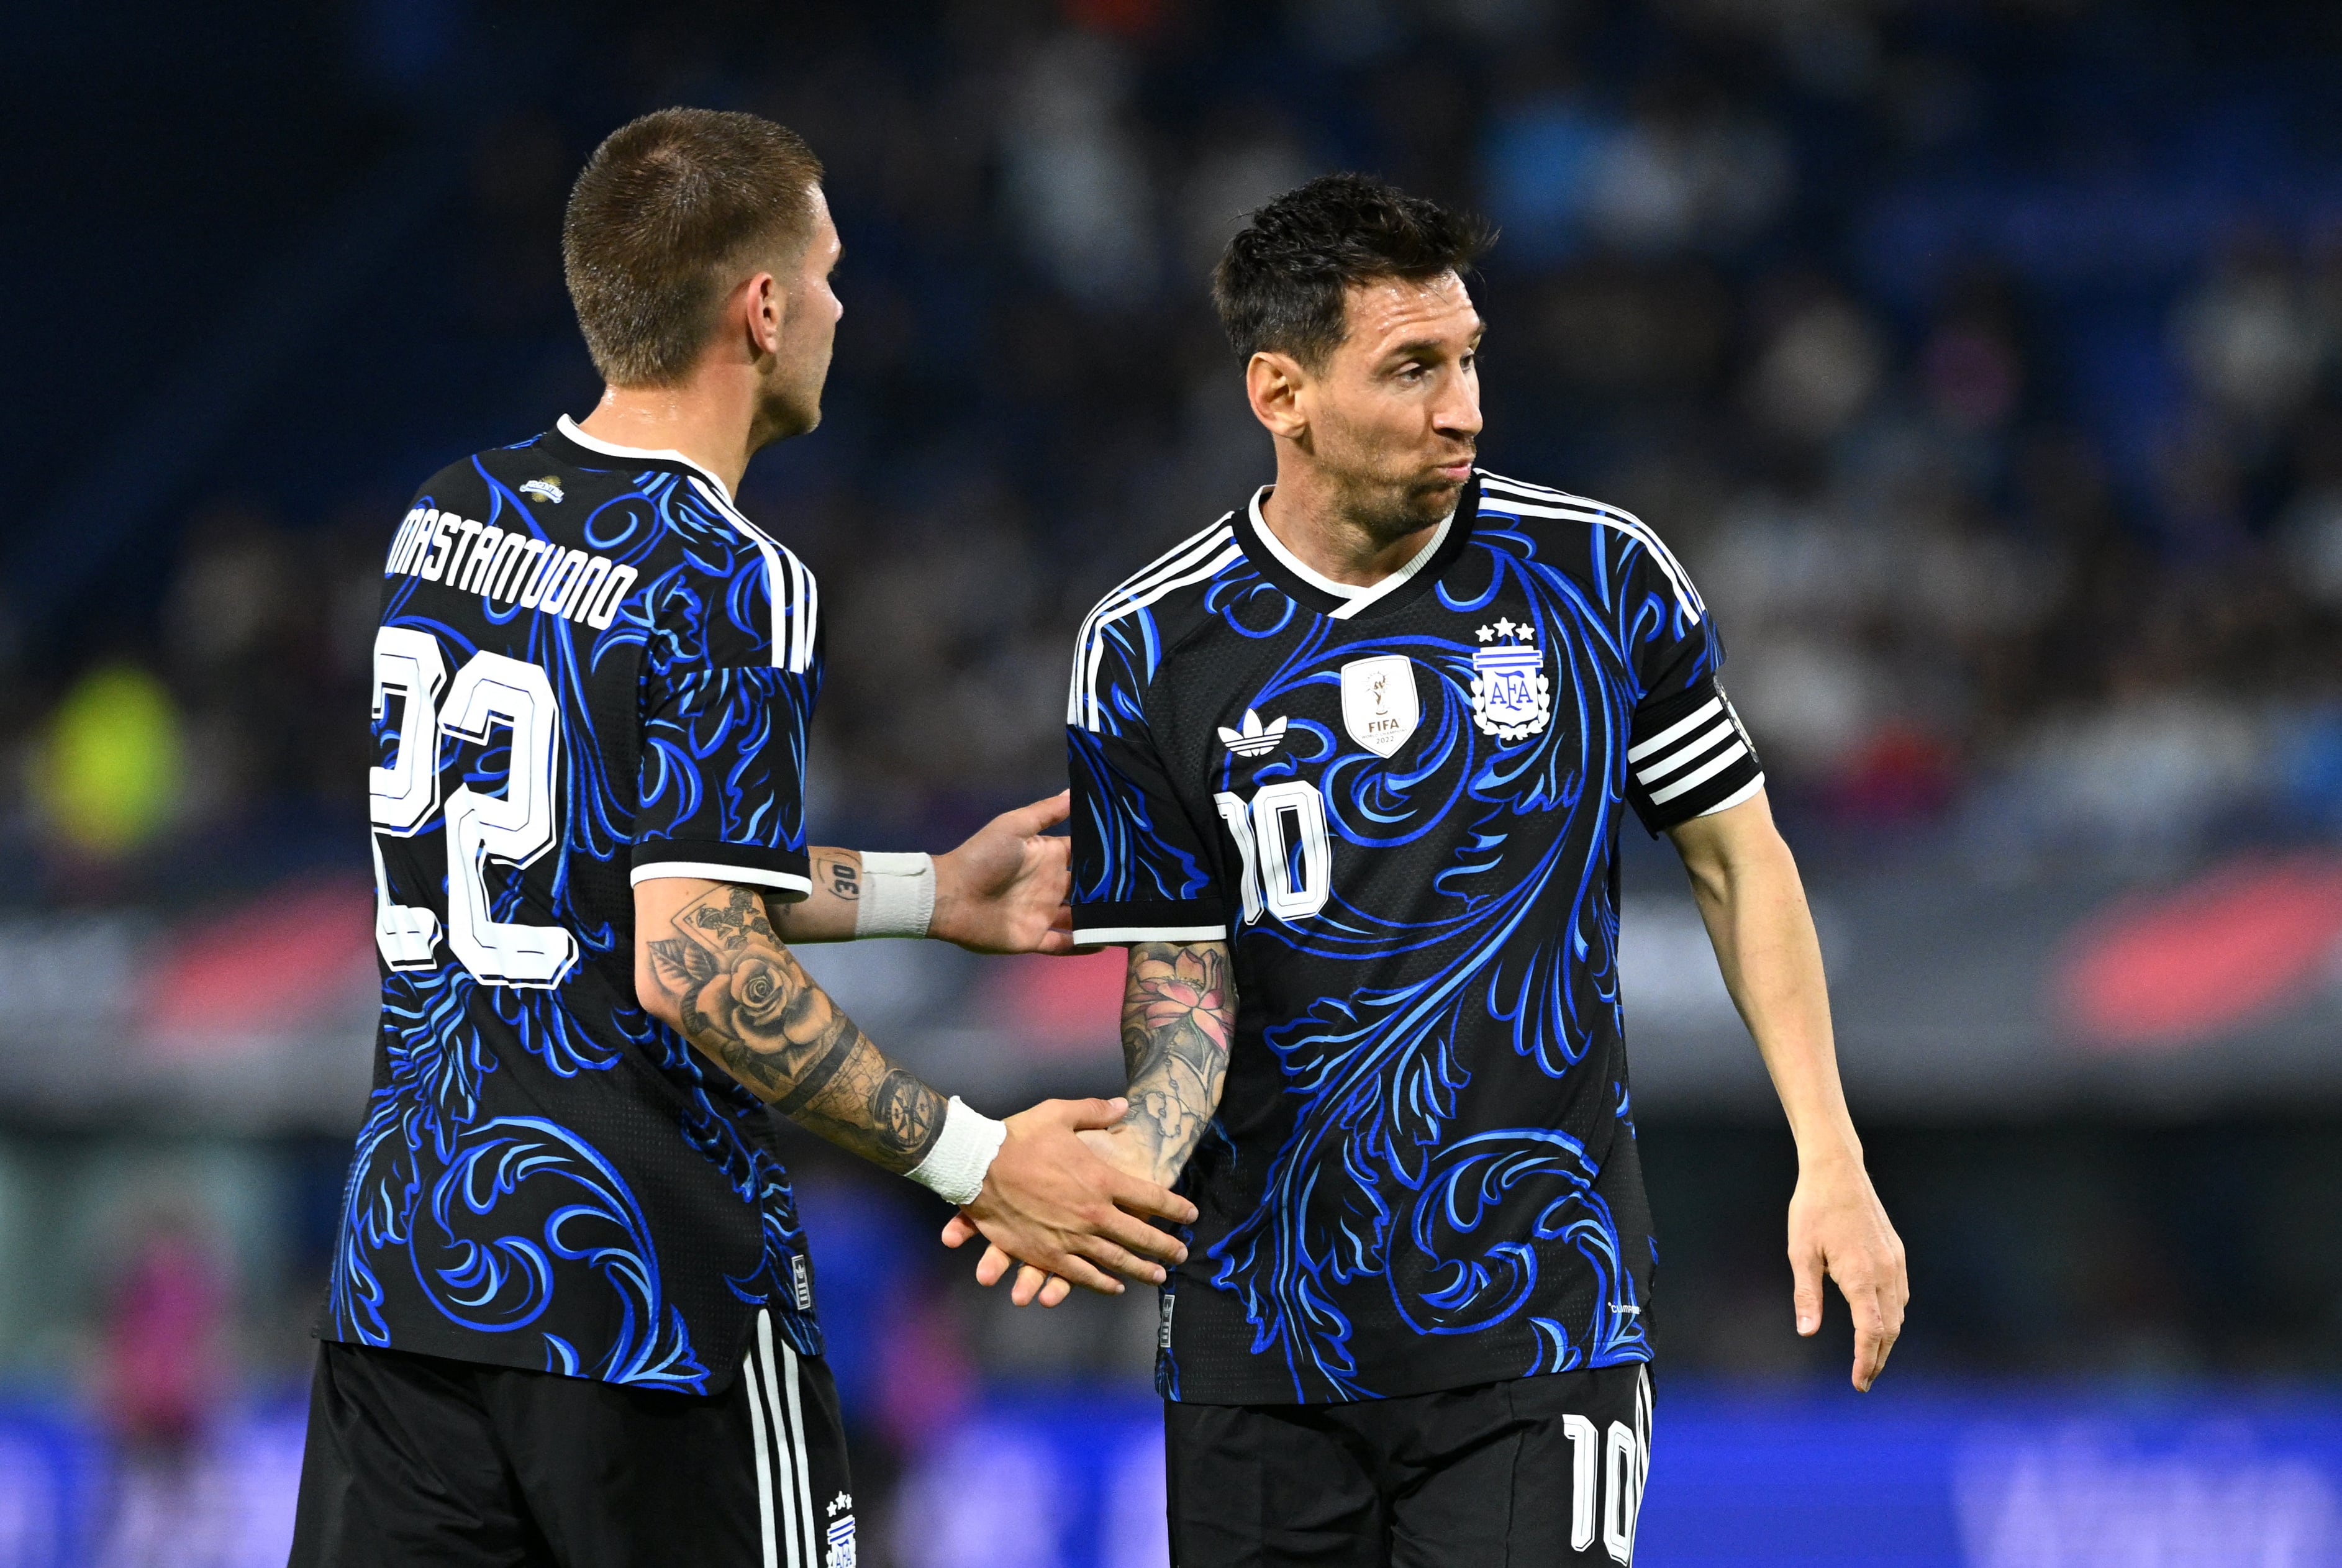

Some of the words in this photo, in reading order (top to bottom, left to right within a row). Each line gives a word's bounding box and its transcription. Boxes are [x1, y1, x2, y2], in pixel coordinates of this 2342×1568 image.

[385, 509, 637, 630] MASTANTUONO
[1368, 718, 1399, 733] FIFA
[1490, 671, 1533, 711] AFA
[1376, 736, 1394, 744] 2022
[370, 626, 579, 989] 22
[833, 864, 860, 894] 30
[1214, 781, 1332, 926] 10
[1562, 1414, 1636, 1567] 10
